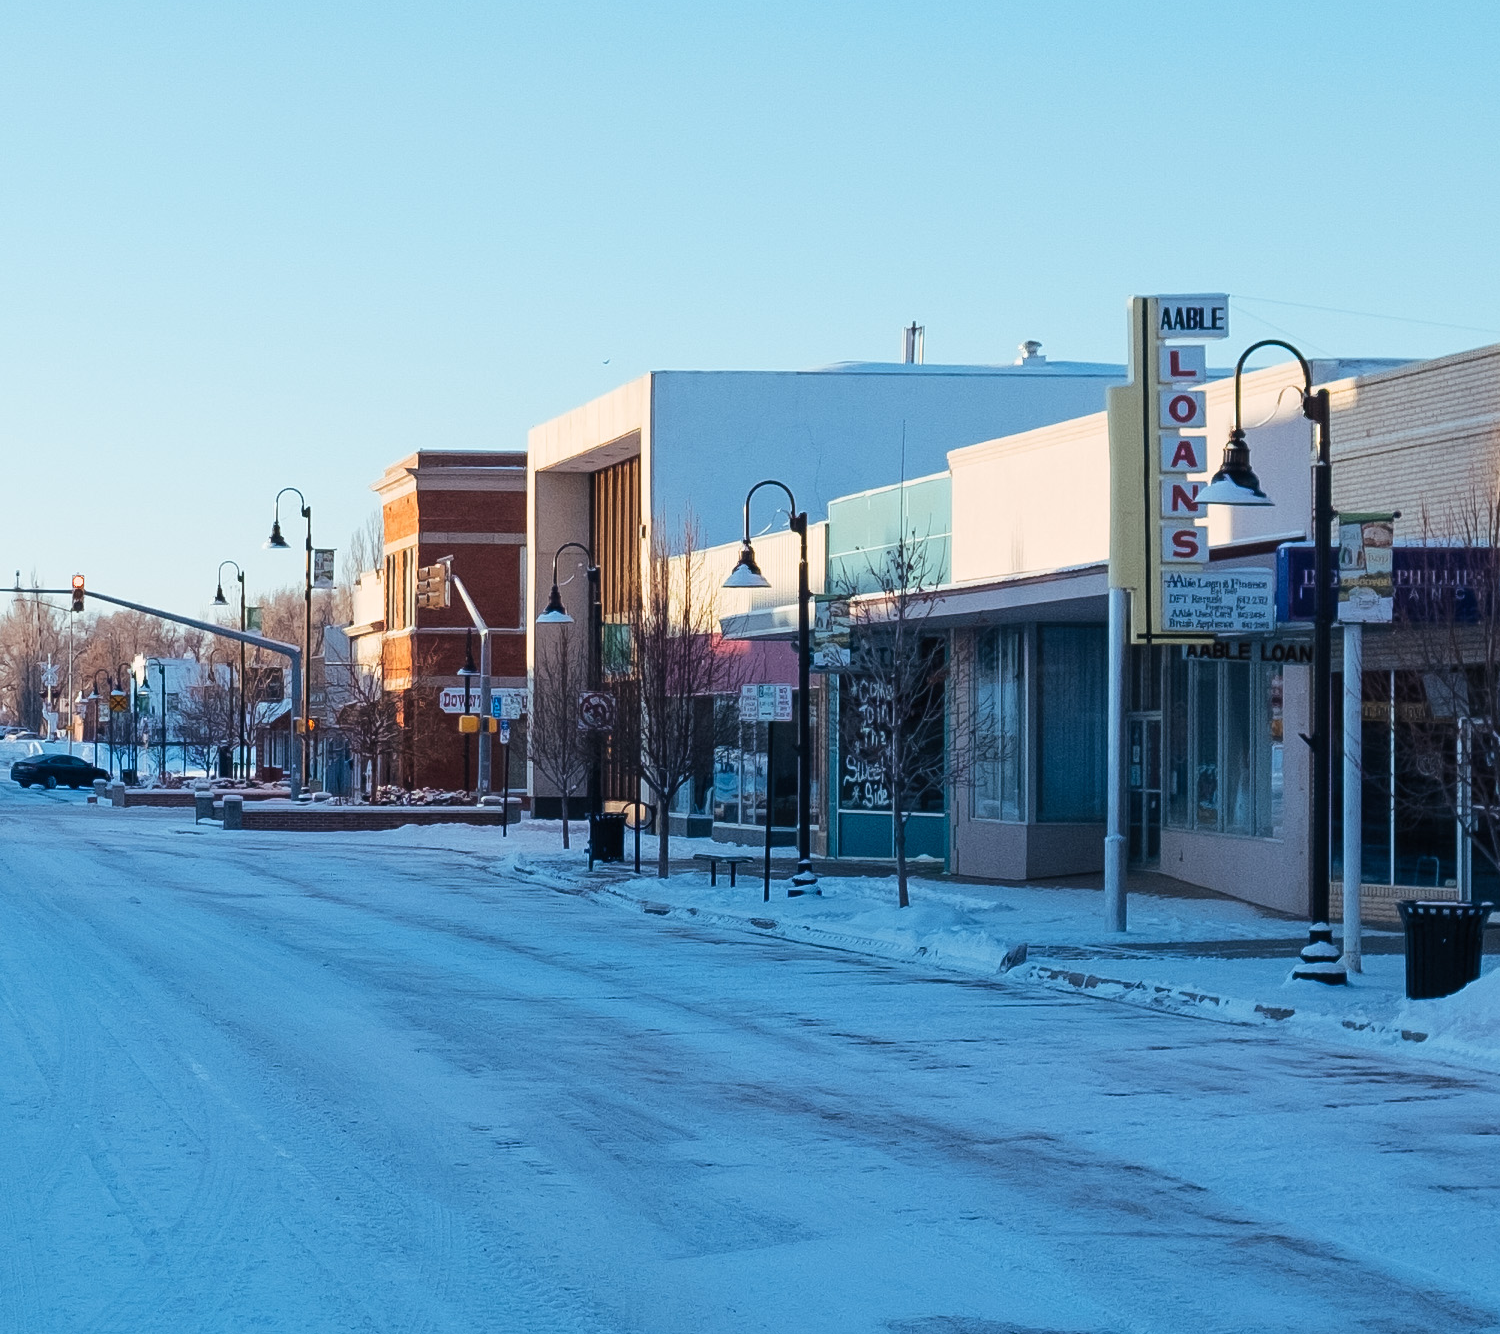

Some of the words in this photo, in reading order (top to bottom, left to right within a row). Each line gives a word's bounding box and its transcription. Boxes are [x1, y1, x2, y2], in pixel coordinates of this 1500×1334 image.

[1160, 306, 1225, 331] AABLE
[1168, 350, 1199, 558] LOANS
[1186, 642, 1250, 660] AABLE
[1261, 643, 1313, 663] LOAN
